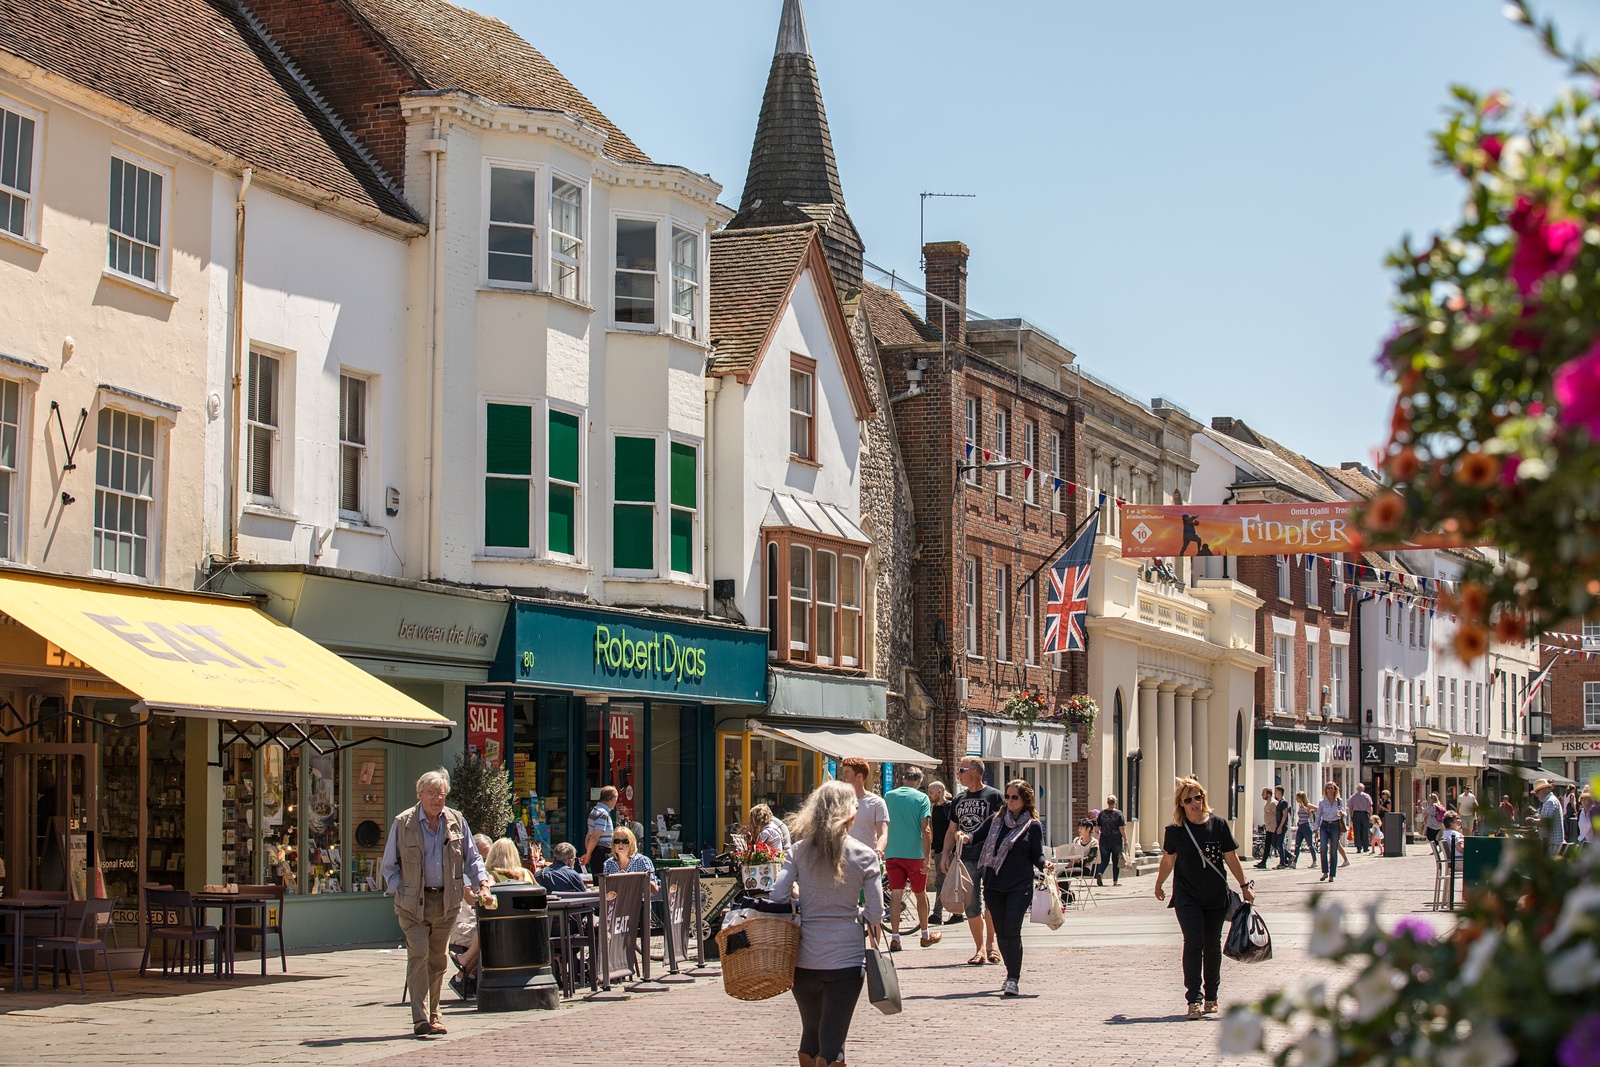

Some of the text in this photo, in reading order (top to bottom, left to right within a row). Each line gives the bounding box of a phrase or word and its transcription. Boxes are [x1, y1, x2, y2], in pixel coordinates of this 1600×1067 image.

[1291, 507, 1309, 515] Omid
[1310, 507, 1330, 517] Djalili
[80, 611, 287, 669] EAT.
[398, 618, 489, 647] between the lines
[46, 640, 91, 668] EA
[524, 651, 535, 667] 80
[596, 625, 706, 682] Robert Dyas
[469, 707, 498, 733] SALE
[609, 717, 629, 739] ALE
[1271, 740, 1320, 753] MOUNTAIN WAREHOUSE
[1562, 742, 1590, 751] HSBC
[957, 806, 986, 816] DYNASTY
[964, 800, 980, 808] DUCK
[112, 911, 164, 923] CROED
[673, 907, 684, 924] EAT.
[614, 915, 630, 935] EAT.
